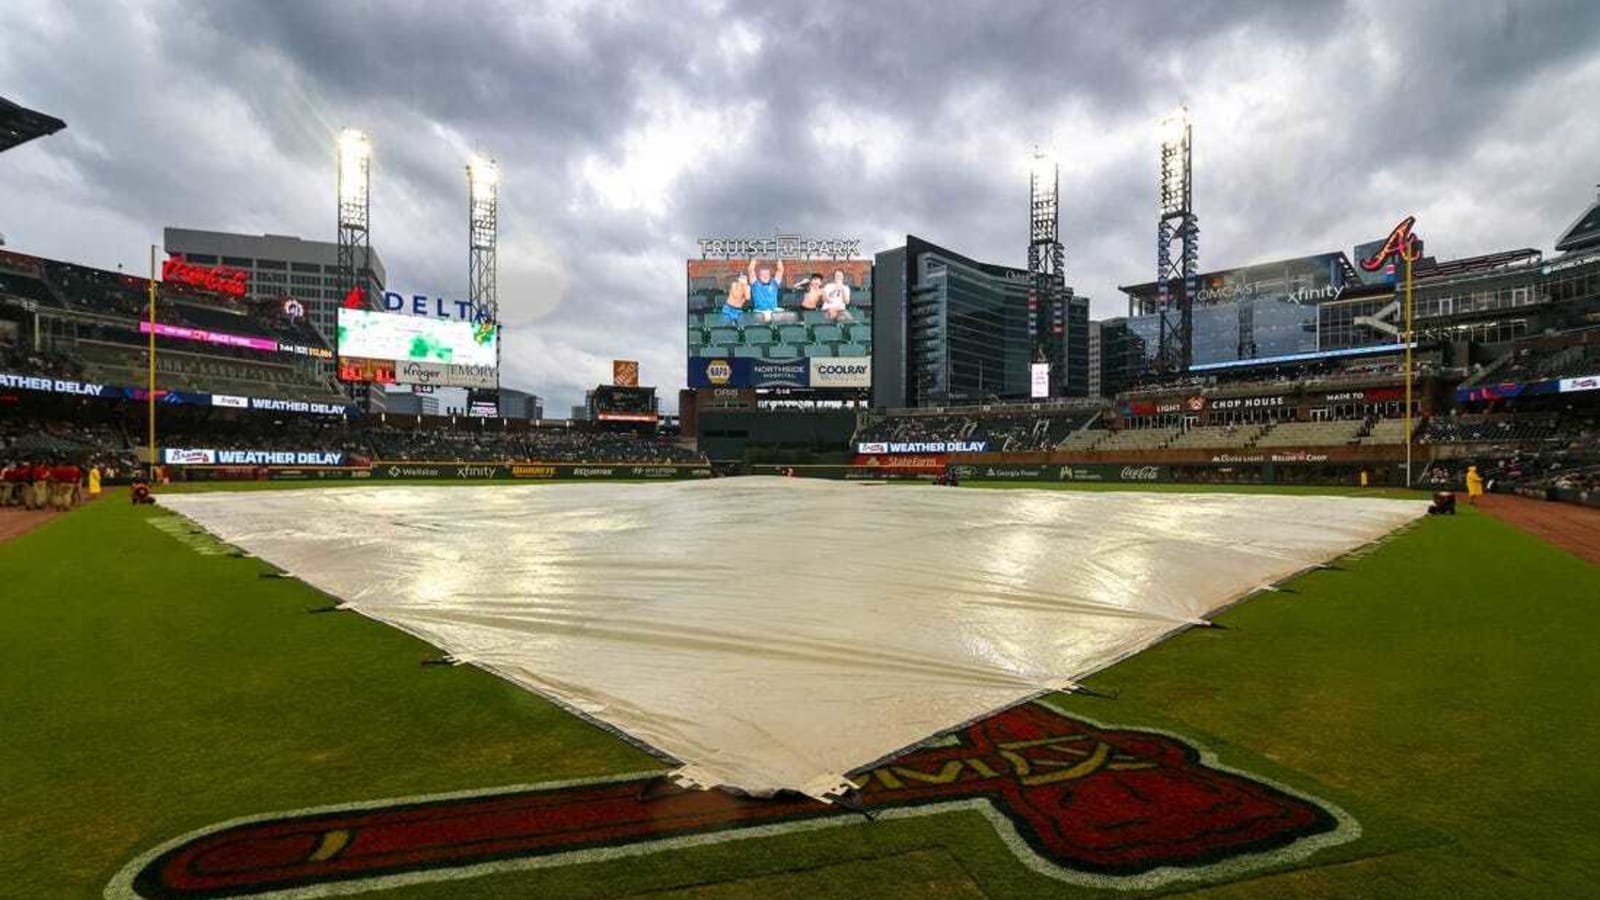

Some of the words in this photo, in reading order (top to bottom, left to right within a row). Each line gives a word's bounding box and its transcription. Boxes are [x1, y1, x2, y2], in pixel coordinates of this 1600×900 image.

[700, 239, 769, 256] TRUIST
[807, 239, 863, 256] PARK
[1197, 281, 1260, 302] OMCAST
[1288, 285, 1344, 304] xfinity
[385, 292, 490, 324] DELTA
[403, 363, 441, 382] Kroger
[754, 365, 805, 373] NORTHSIDE
[818, 366, 867, 376] COOLRAY
[0, 374, 51, 391] ATHER
[55, 381, 104, 397] DELAY
[1212, 400, 1242, 410] CHOP
[1245, 397, 1284, 407] HOUSE
[1327, 393, 1350, 401] MADE
[1352, 392, 1364, 400] TO
[252, 398, 310, 413] WEATHER
[311, 403, 346, 415] DELAY
[1156, 404, 1181, 413] LIGHT
[889, 442, 946, 453] WEATHER
[947, 441, 986, 452] DELAY
[218, 451, 296, 464] WEATHER
[297, 452, 342, 465] DELAY
[456, 465, 497, 479] xfinity
